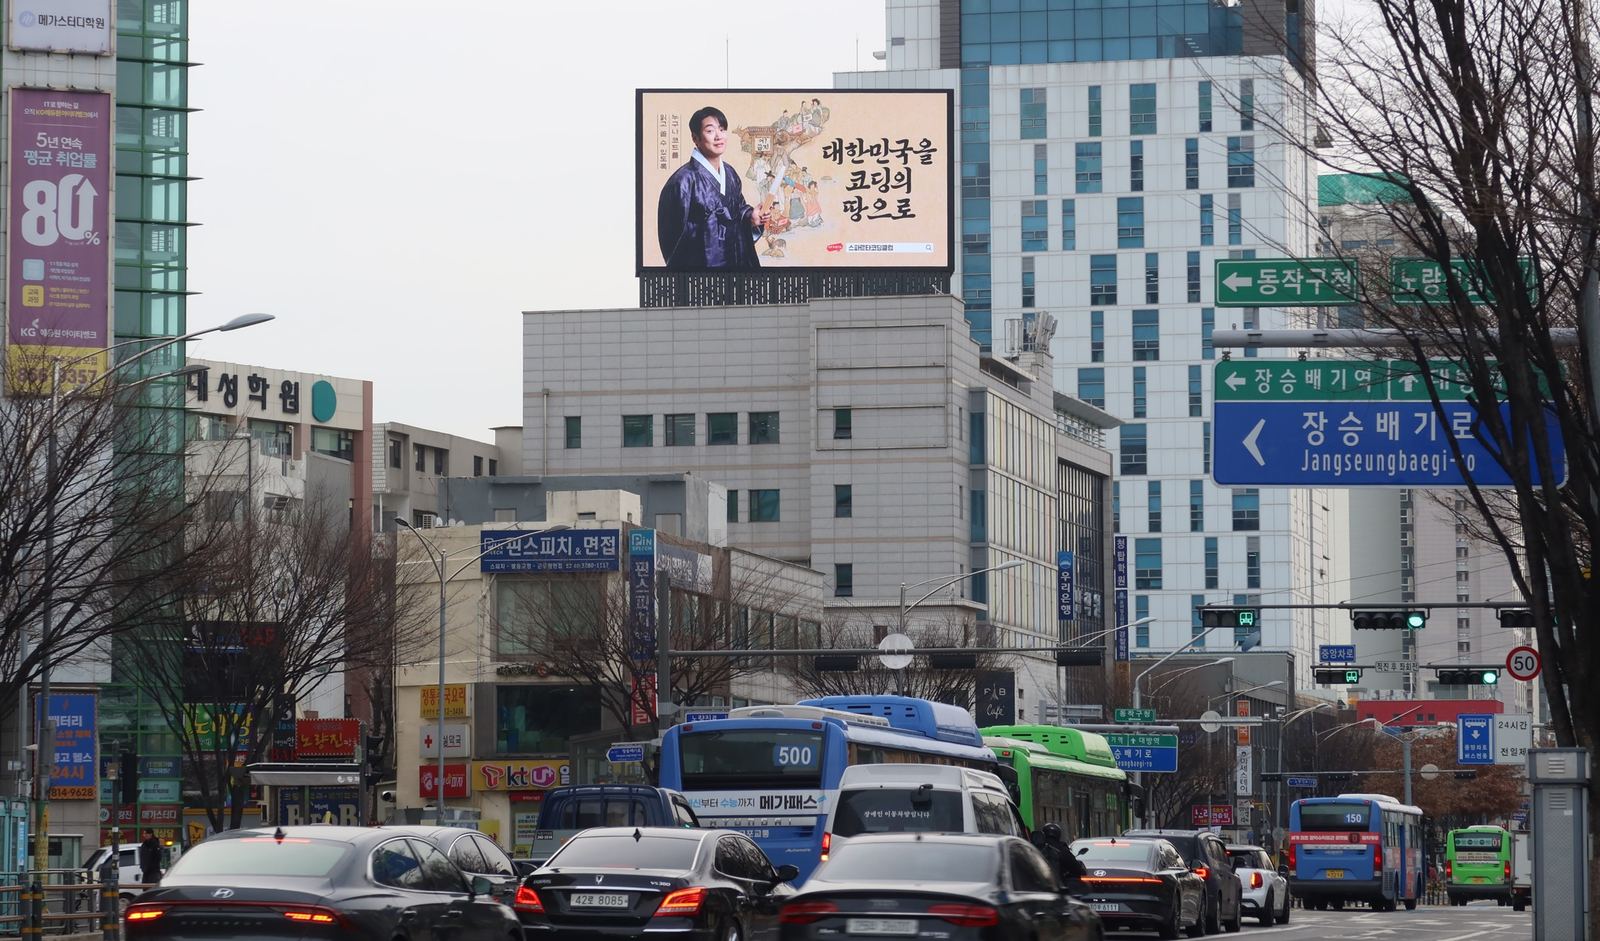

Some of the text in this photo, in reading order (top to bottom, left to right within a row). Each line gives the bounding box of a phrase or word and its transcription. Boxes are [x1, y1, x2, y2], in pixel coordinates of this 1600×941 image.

[38, 14, 105, 30] 메가스터디학원
[36, 132, 83, 150] 5년 연속
[24, 150, 98, 168] 평균 취업률
[821, 138, 938, 166] 대한민국을
[846, 167, 913, 195] 코딩의
[843, 196, 917, 222] 땅으로
[1257, 268, 1352, 296] 동작구청
[20, 328, 37, 337] KG
[1255, 368, 1372, 395] 장승배기역
[187, 366, 300, 414] 대성학원
[1301, 411, 1477, 447] 장승배기로
[584, 536, 616, 557] 면접
[1060, 571, 1072, 616] 우리은행
[1320, 648, 1355, 660] 중앙차로
[1377, 662, 1390, 672] 직진
[1513, 655, 1535, 671] 50
[422, 687, 466, 706] 정통국요리
[998, 687, 1006, 696] B
[1119, 710, 1151, 719] 동작구청
[1498, 721, 1528, 731] 24시간
[301, 732, 344, 749] 노량진
[1138, 736, 1160, 746] 대방역
[72, 752, 93, 763] 헬스
[778, 745, 812, 766] 500
[1113, 749, 1153, 760] 승배기로
[1500, 747, 1527, 757] 전일제
[507, 765, 528, 786] kt
[51, 787, 94, 797] 814-9628
[719, 798, 756, 808] 수능까지
[758, 795, 819, 811] 메가패스
[1345, 813, 1362, 823] 150
[598, 895, 624, 906] 8085
